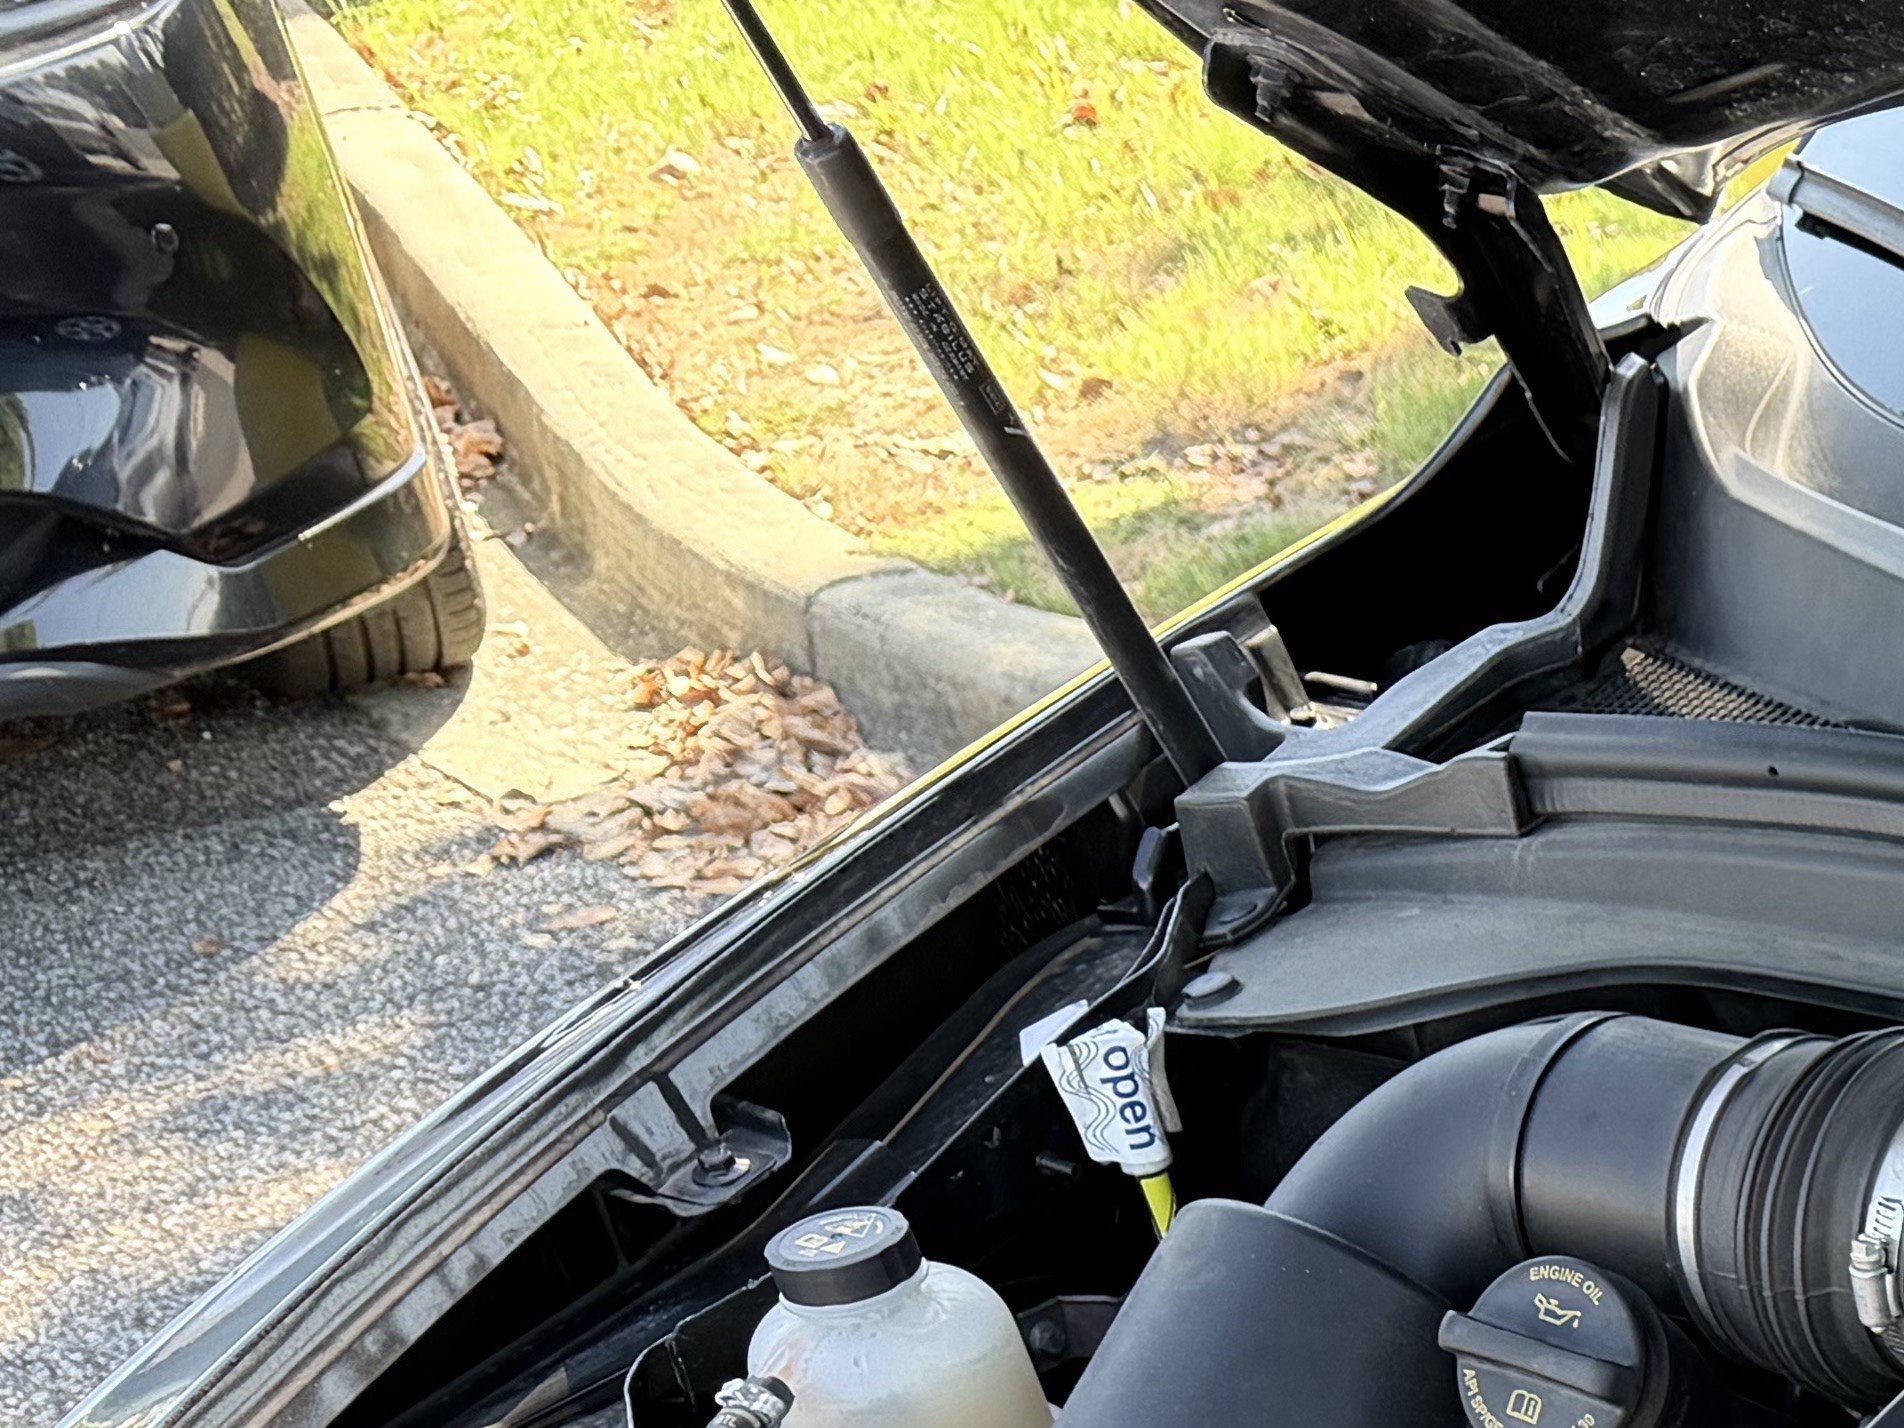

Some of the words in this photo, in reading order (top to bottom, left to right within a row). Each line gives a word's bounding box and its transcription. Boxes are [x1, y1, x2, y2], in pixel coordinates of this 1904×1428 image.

[917, 285, 975, 376] STABILUS
[1100, 1045, 1157, 1151] open
[1529, 1265, 1584, 1287] ENGINE
[1582, 1280, 1604, 1306] OIL
[1462, 1368, 1477, 1396] API
